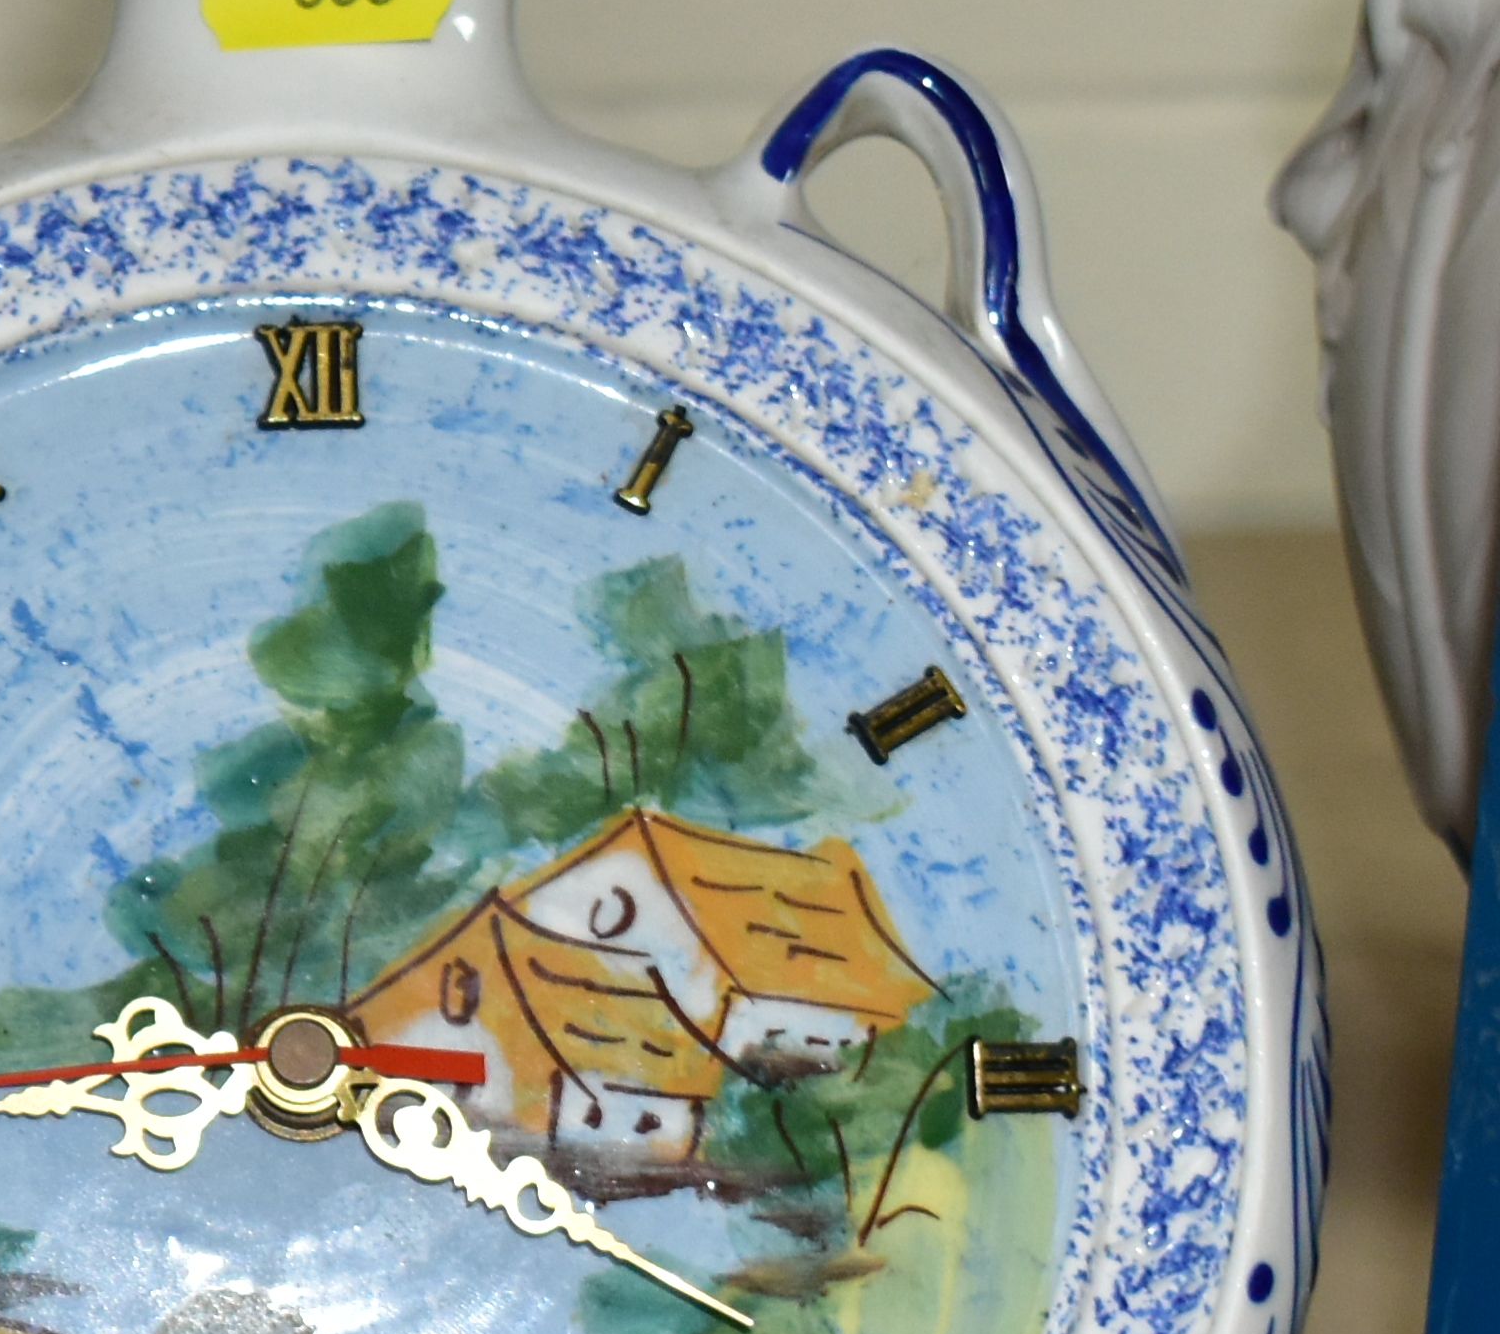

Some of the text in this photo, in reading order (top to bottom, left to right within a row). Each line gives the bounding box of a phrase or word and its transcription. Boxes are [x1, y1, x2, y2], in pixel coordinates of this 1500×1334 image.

[255, 317, 364, 430] XII
[613, 405, 693, 516] I
[847, 665, 967, 765] II
[966, 1034, 1082, 1120] III
